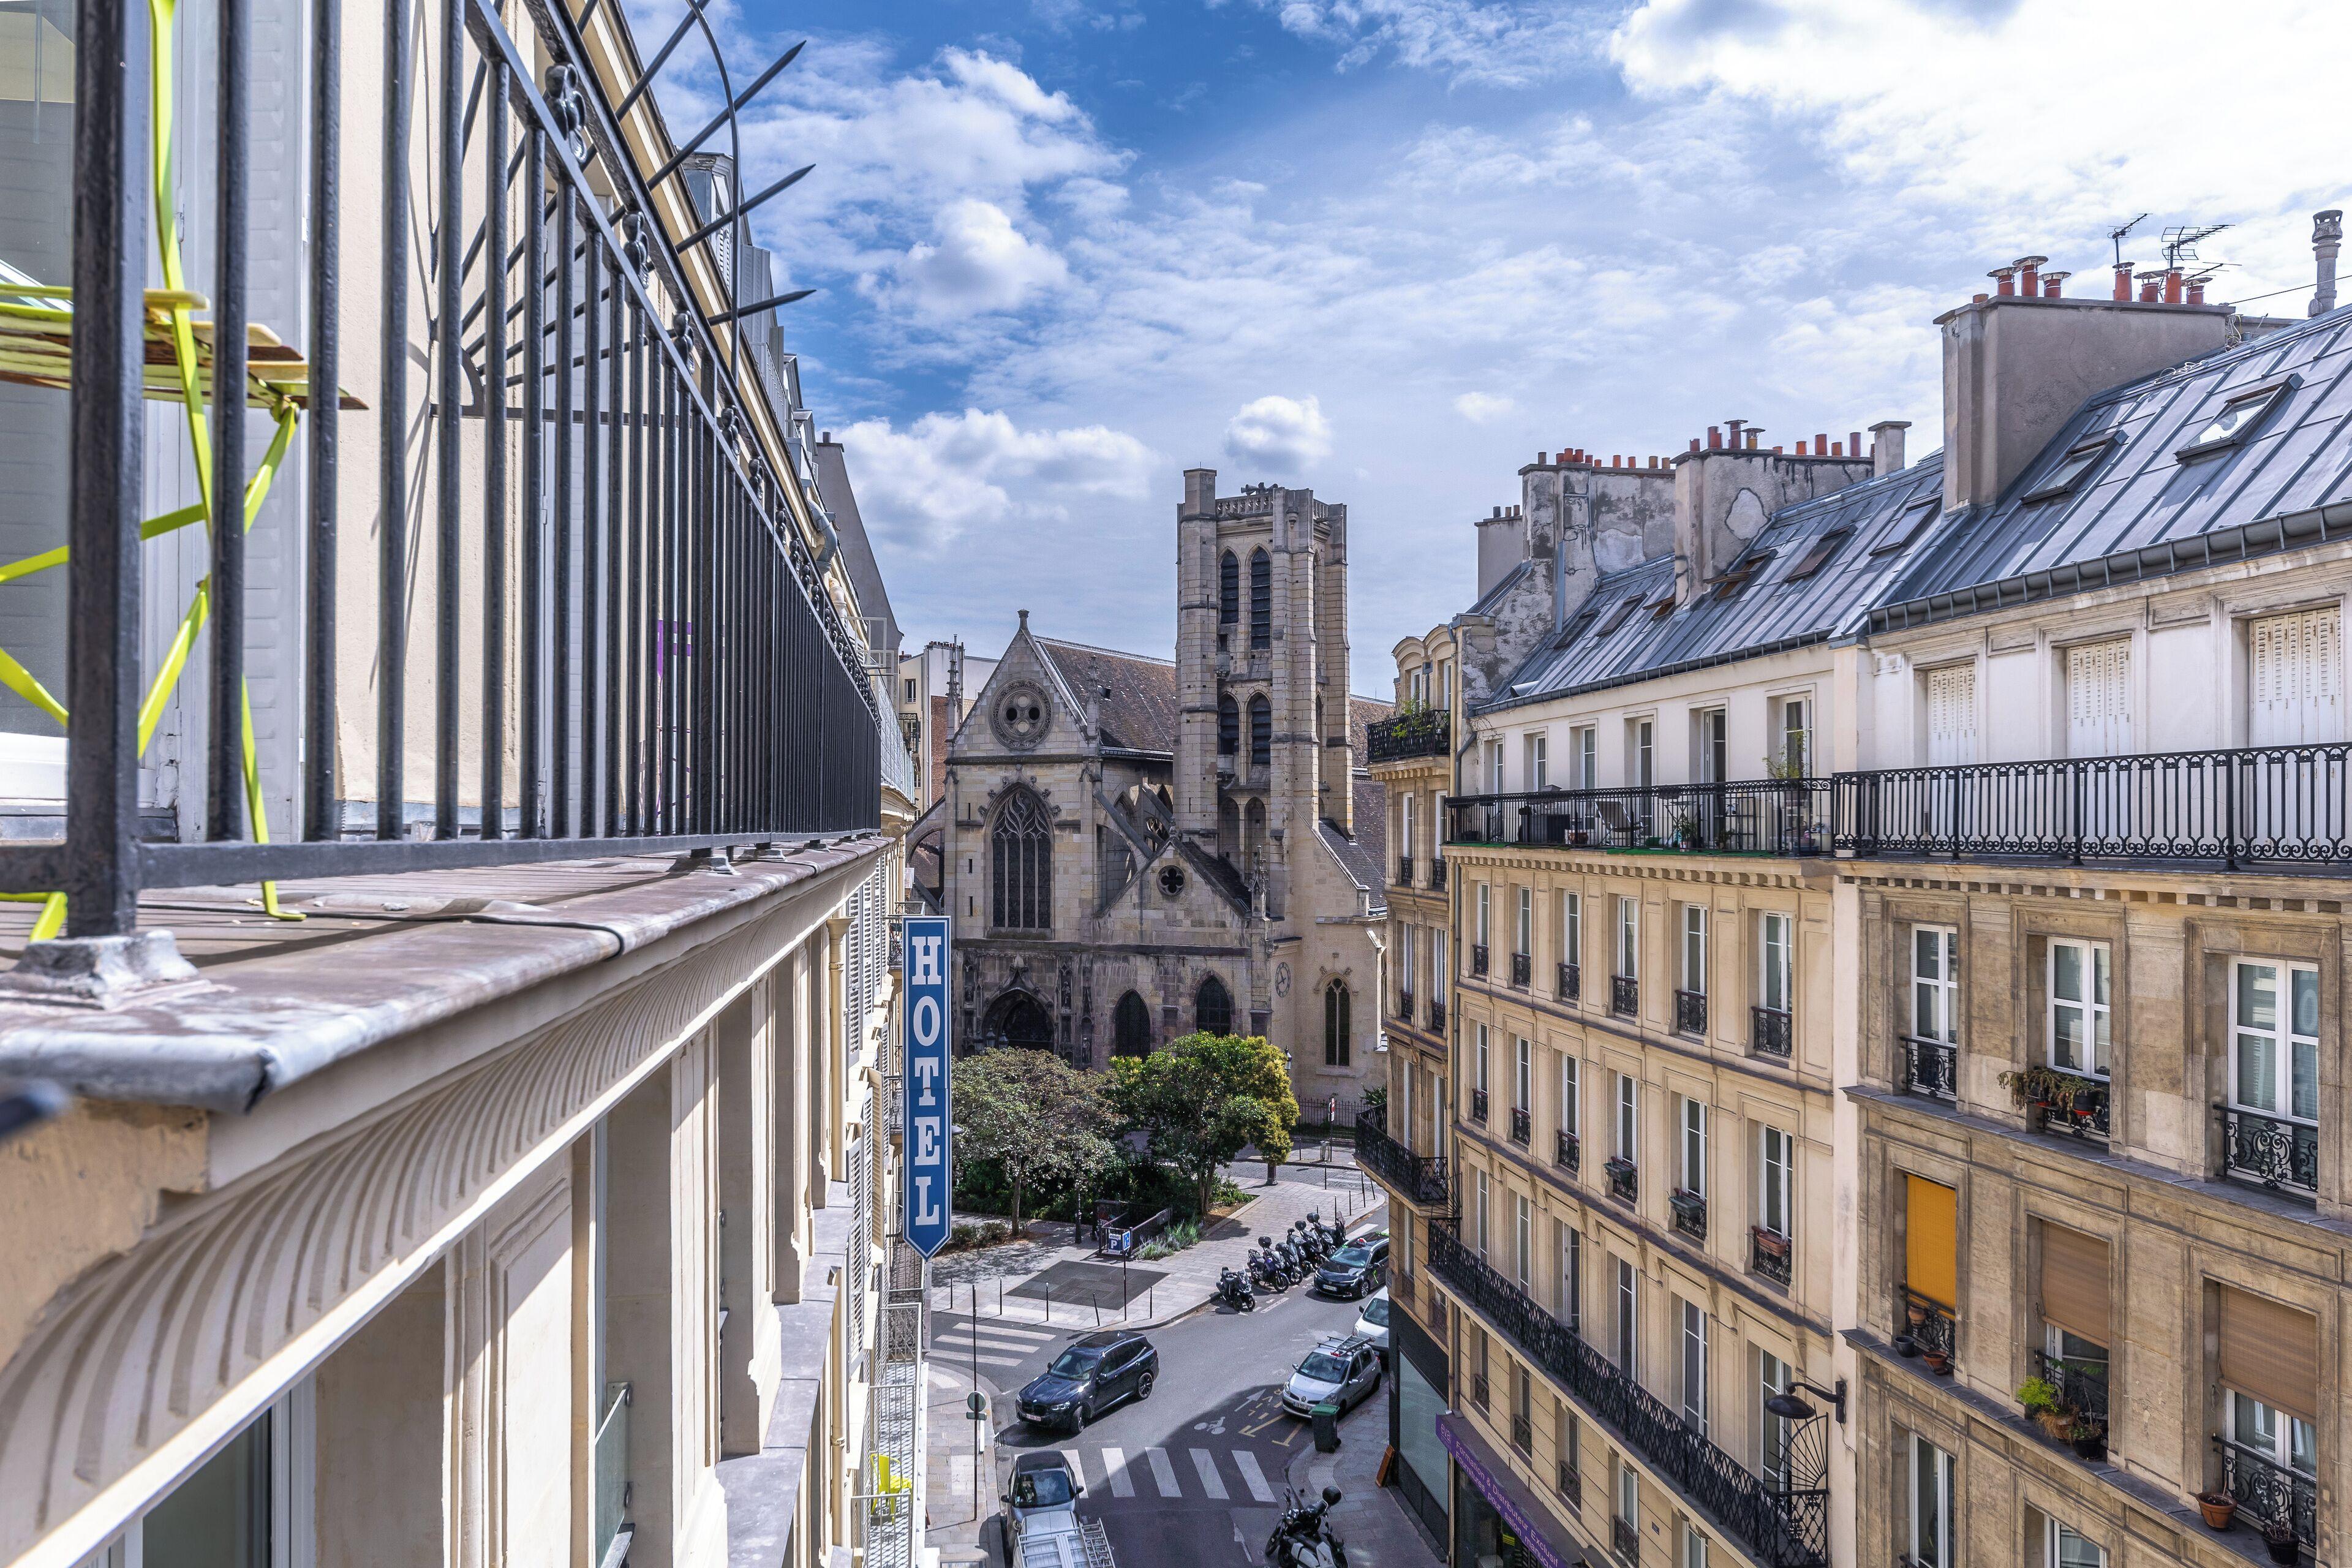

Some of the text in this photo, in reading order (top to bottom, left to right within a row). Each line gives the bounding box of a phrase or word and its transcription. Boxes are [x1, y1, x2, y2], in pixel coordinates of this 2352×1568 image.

[912, 936, 942, 1226] HOTEL
[1111, 1240, 1117, 1249] P
[1455, 1450, 1485, 1492] Fournitures
[1488, 1492, 1502, 1512] pour
[1504, 1512, 1521, 1536] salon
[1456, 1441, 1558, 1567] Formation & Distributeur Exclusif
